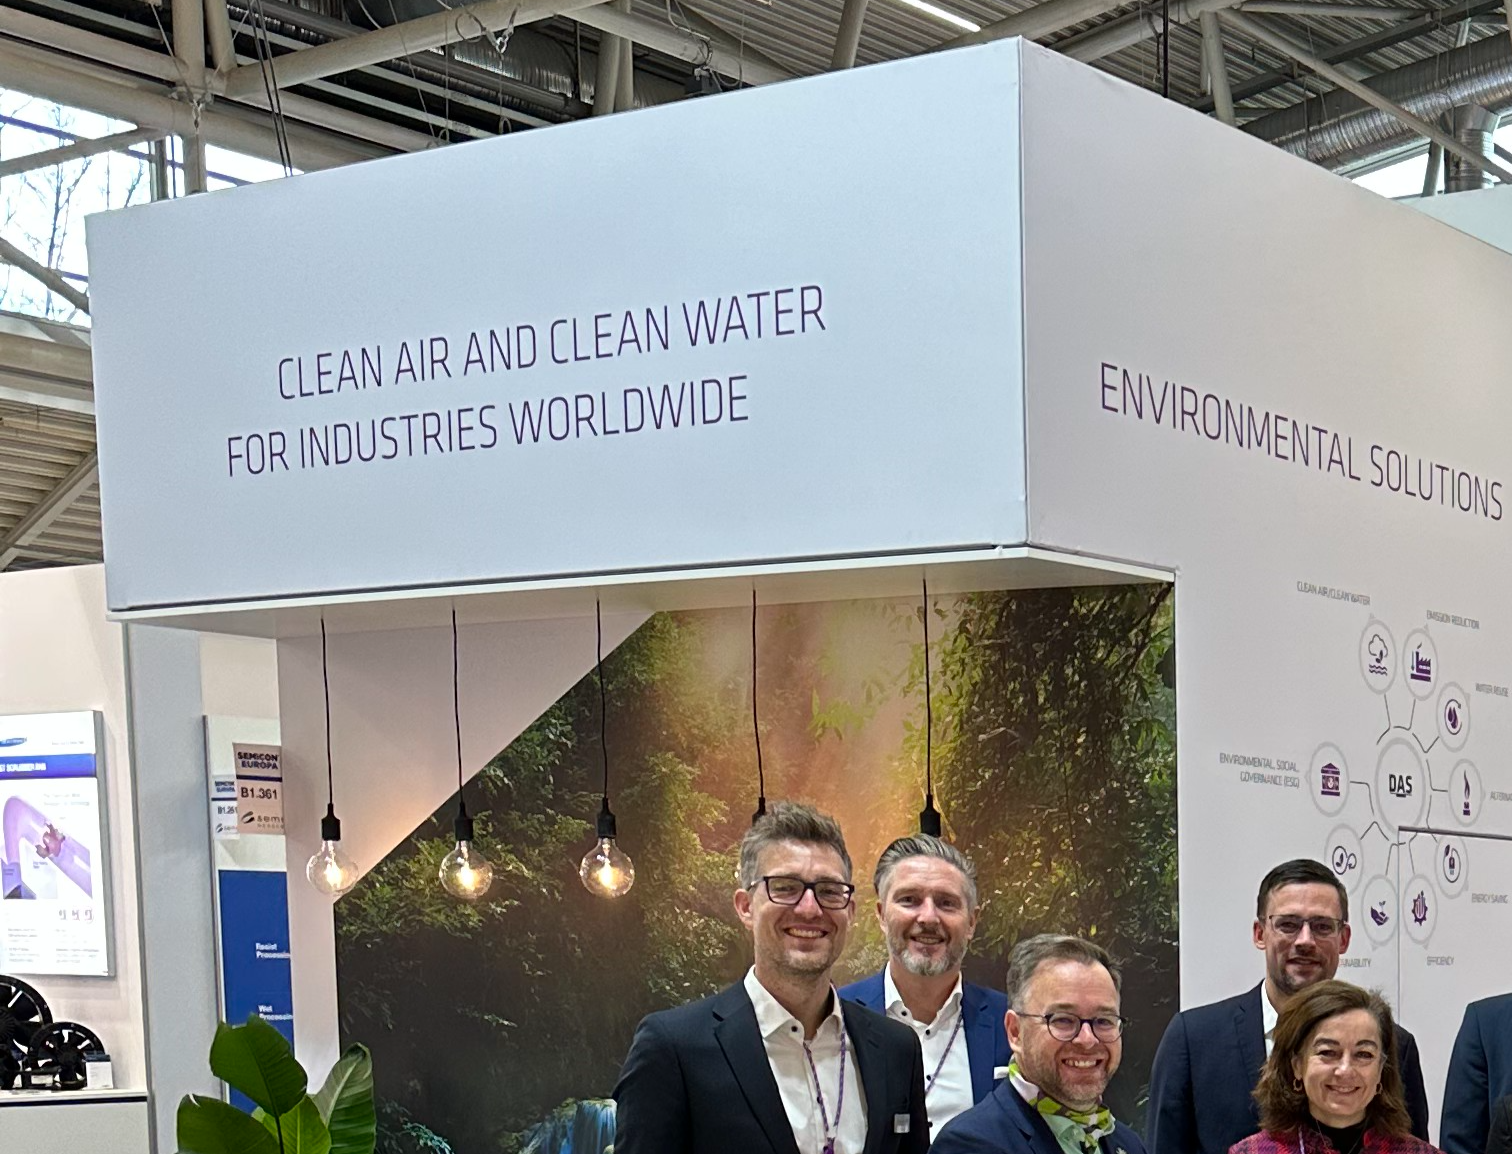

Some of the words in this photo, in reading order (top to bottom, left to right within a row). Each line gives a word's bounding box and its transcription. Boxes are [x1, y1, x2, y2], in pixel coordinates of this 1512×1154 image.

[278, 345, 383, 400] CLEAN
[394, 336, 452, 386] AIR
[463, 324, 537, 377] AND
[549, 305, 669, 364] CLEAN
[682, 285, 826, 347] WATER
[227, 431, 290, 478] FOR
[299, 404, 498, 470] INDUSTRIES
[508, 374, 749, 445] WORLDWIDE
[1100, 361, 1362, 482] ENVIRONMENTAL
[1370, 444, 1503, 521] SOLUTIONS
[238, 752, 278, 762] SEMICON
[241, 761, 279, 770] EUROPA
[241, 787, 278, 800] B1.361
[1388, 774, 1413, 795] DAS
